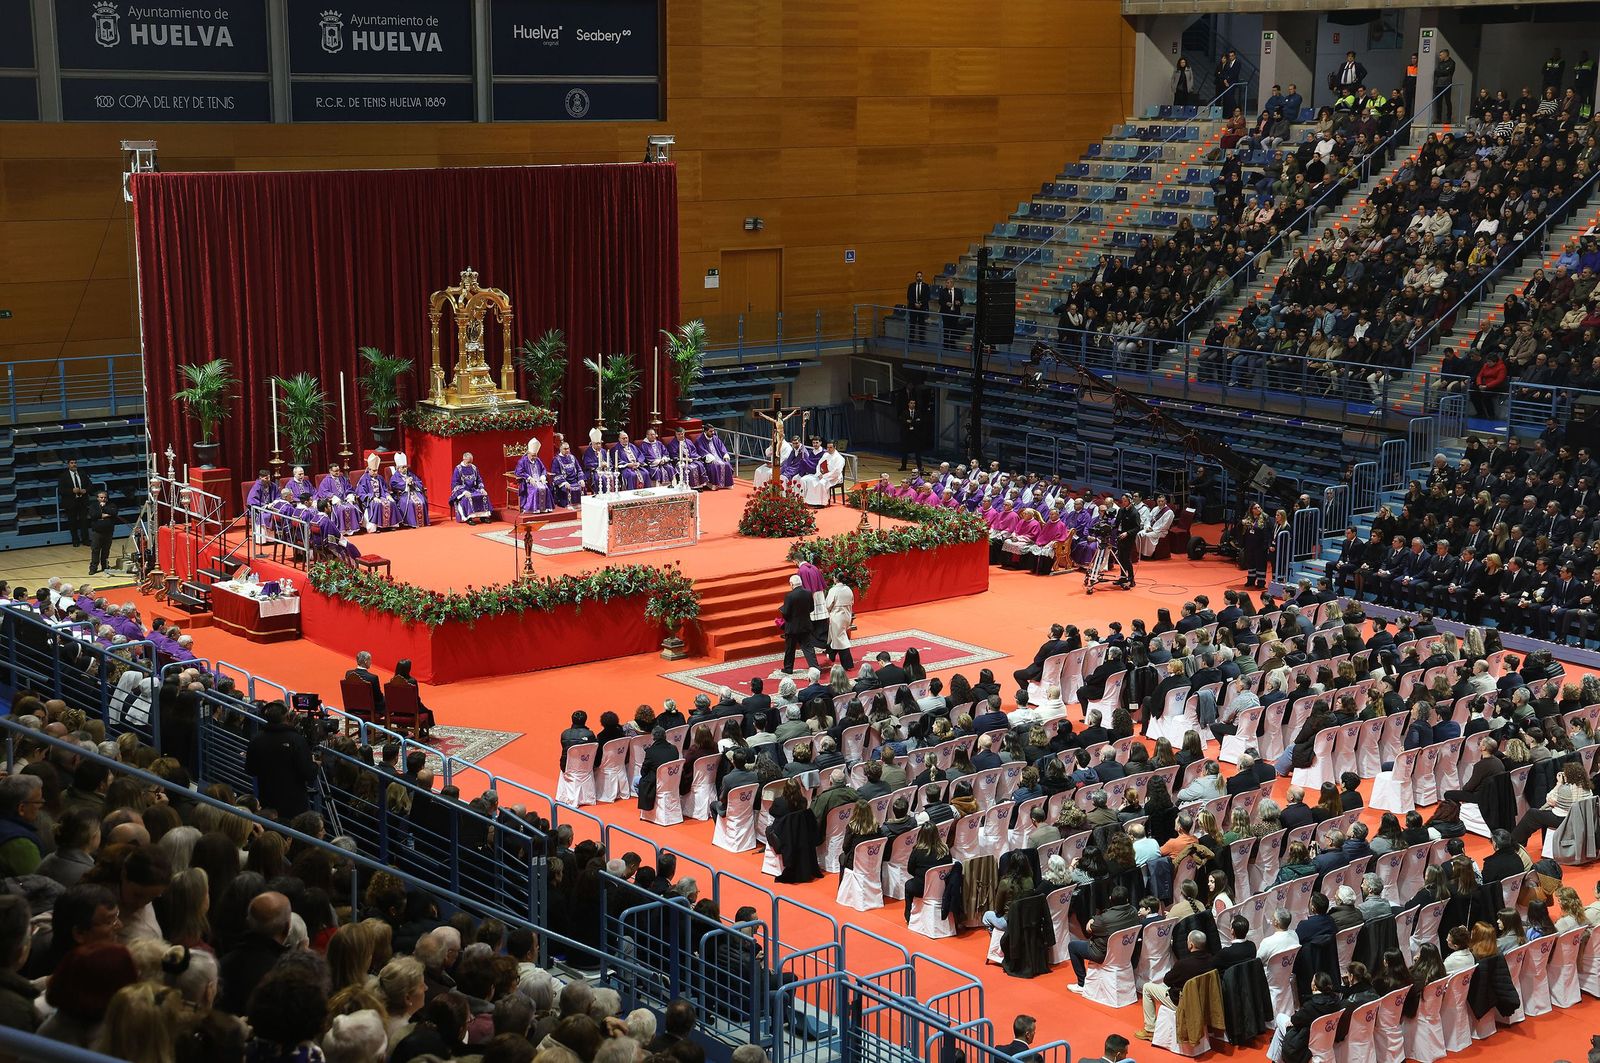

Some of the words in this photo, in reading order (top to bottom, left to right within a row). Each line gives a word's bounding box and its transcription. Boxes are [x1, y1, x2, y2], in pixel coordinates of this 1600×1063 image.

[128, 6, 211, 20] Ayuntamiento
[214, 8, 229, 20] de
[350, 14, 423, 28] Ayuntamiento
[426, 16, 439, 26] de
[130, 23, 234, 47] HUELVA
[513, 24, 559, 39] Huelva
[576, 29, 622, 44] Seabery
[352, 31, 443, 52] HUELVA
[118, 95, 152, 109] COPA
[154, 96, 170, 109] DEL
[173, 96, 190, 109] REY
[193, 97, 205, 109] DE
[207, 97, 235, 109] TENIS
[316, 97, 346, 108] R.C.R.
[349, 98, 360, 107] DE
[362, 98, 387, 108] TENIS
[389, 98, 422, 108] HUELVA
[424, 97, 446, 108] 1889
